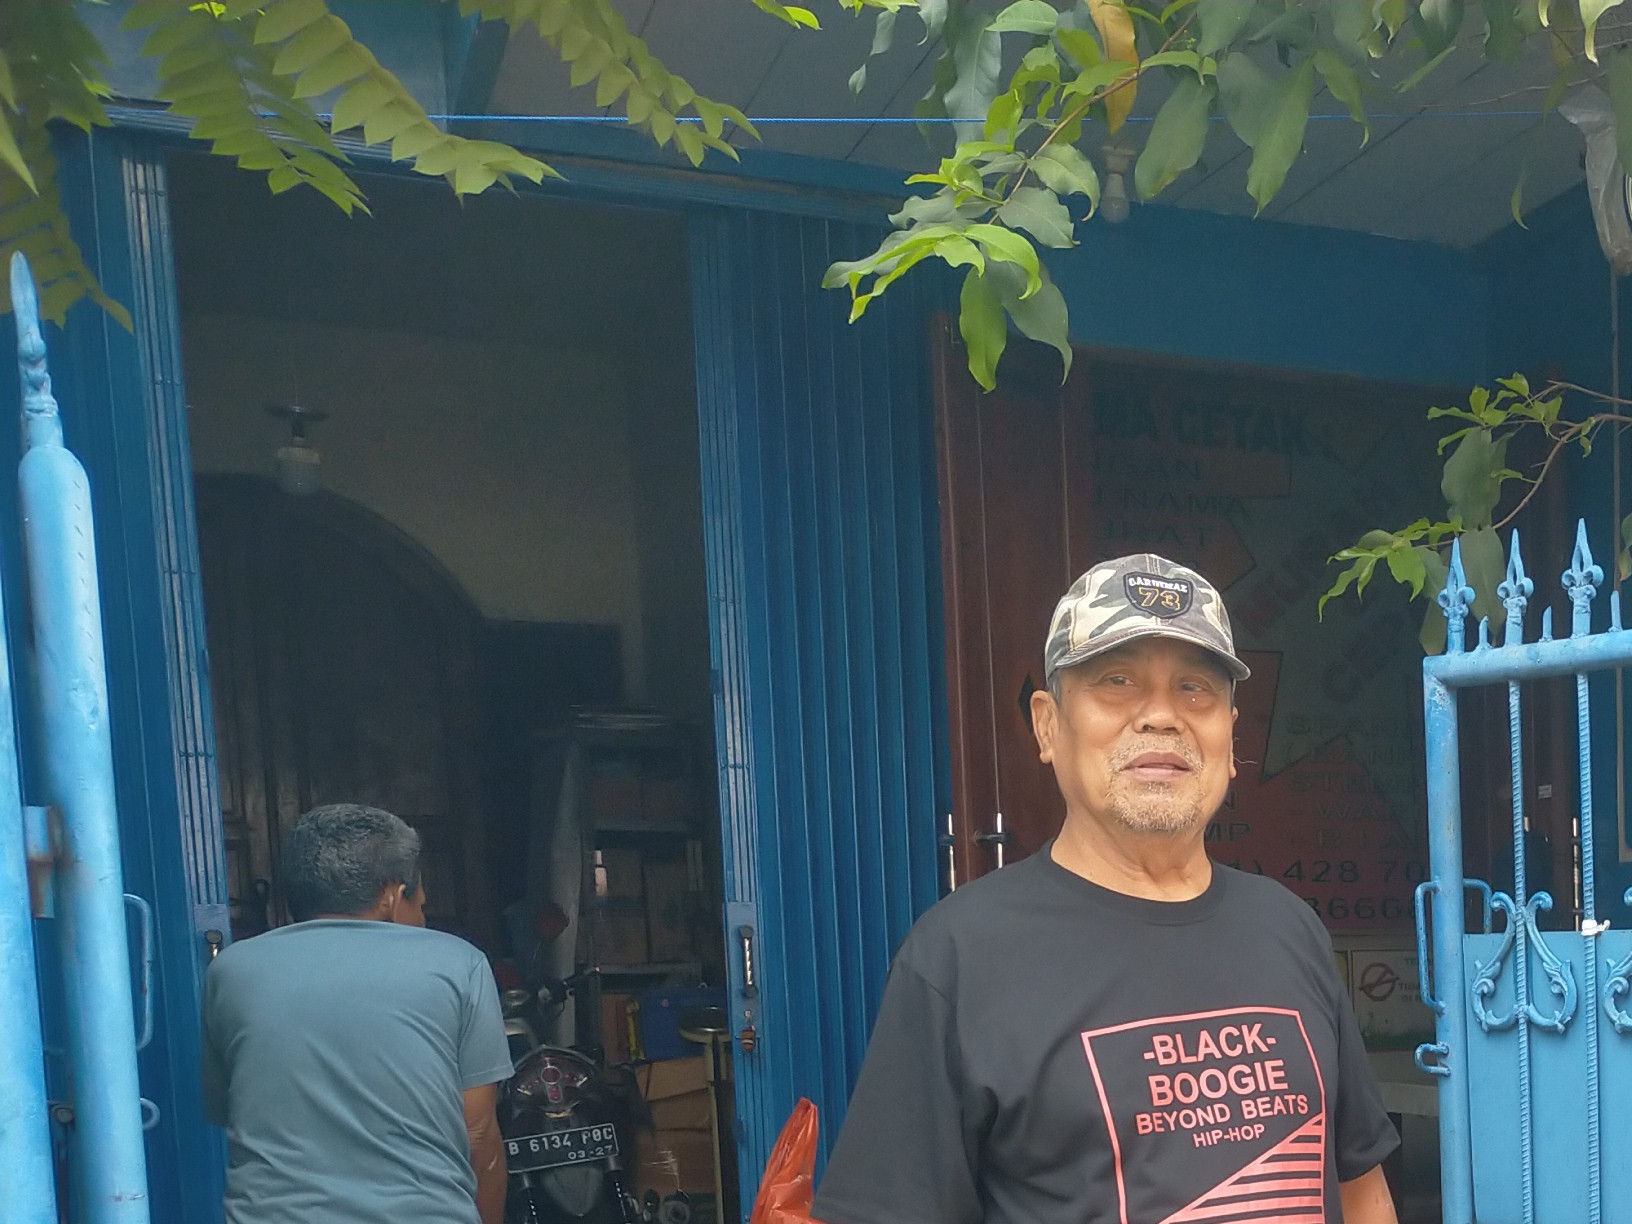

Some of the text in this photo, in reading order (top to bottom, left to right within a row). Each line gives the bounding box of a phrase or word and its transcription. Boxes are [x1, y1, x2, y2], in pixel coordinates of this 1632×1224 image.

[1138, 587, 1181, 612] 73
[1283, 859, 1360, 884] 428
[1148, 1059, 1289, 1107] BOOGIE
[1135, 1094, 1309, 1135] BEYOND BEATS
[508, 1142, 520, 1156] B
[529, 1133, 572, 1152] 6134
[1193, 1123, 1266, 1148] HIP-HOP
